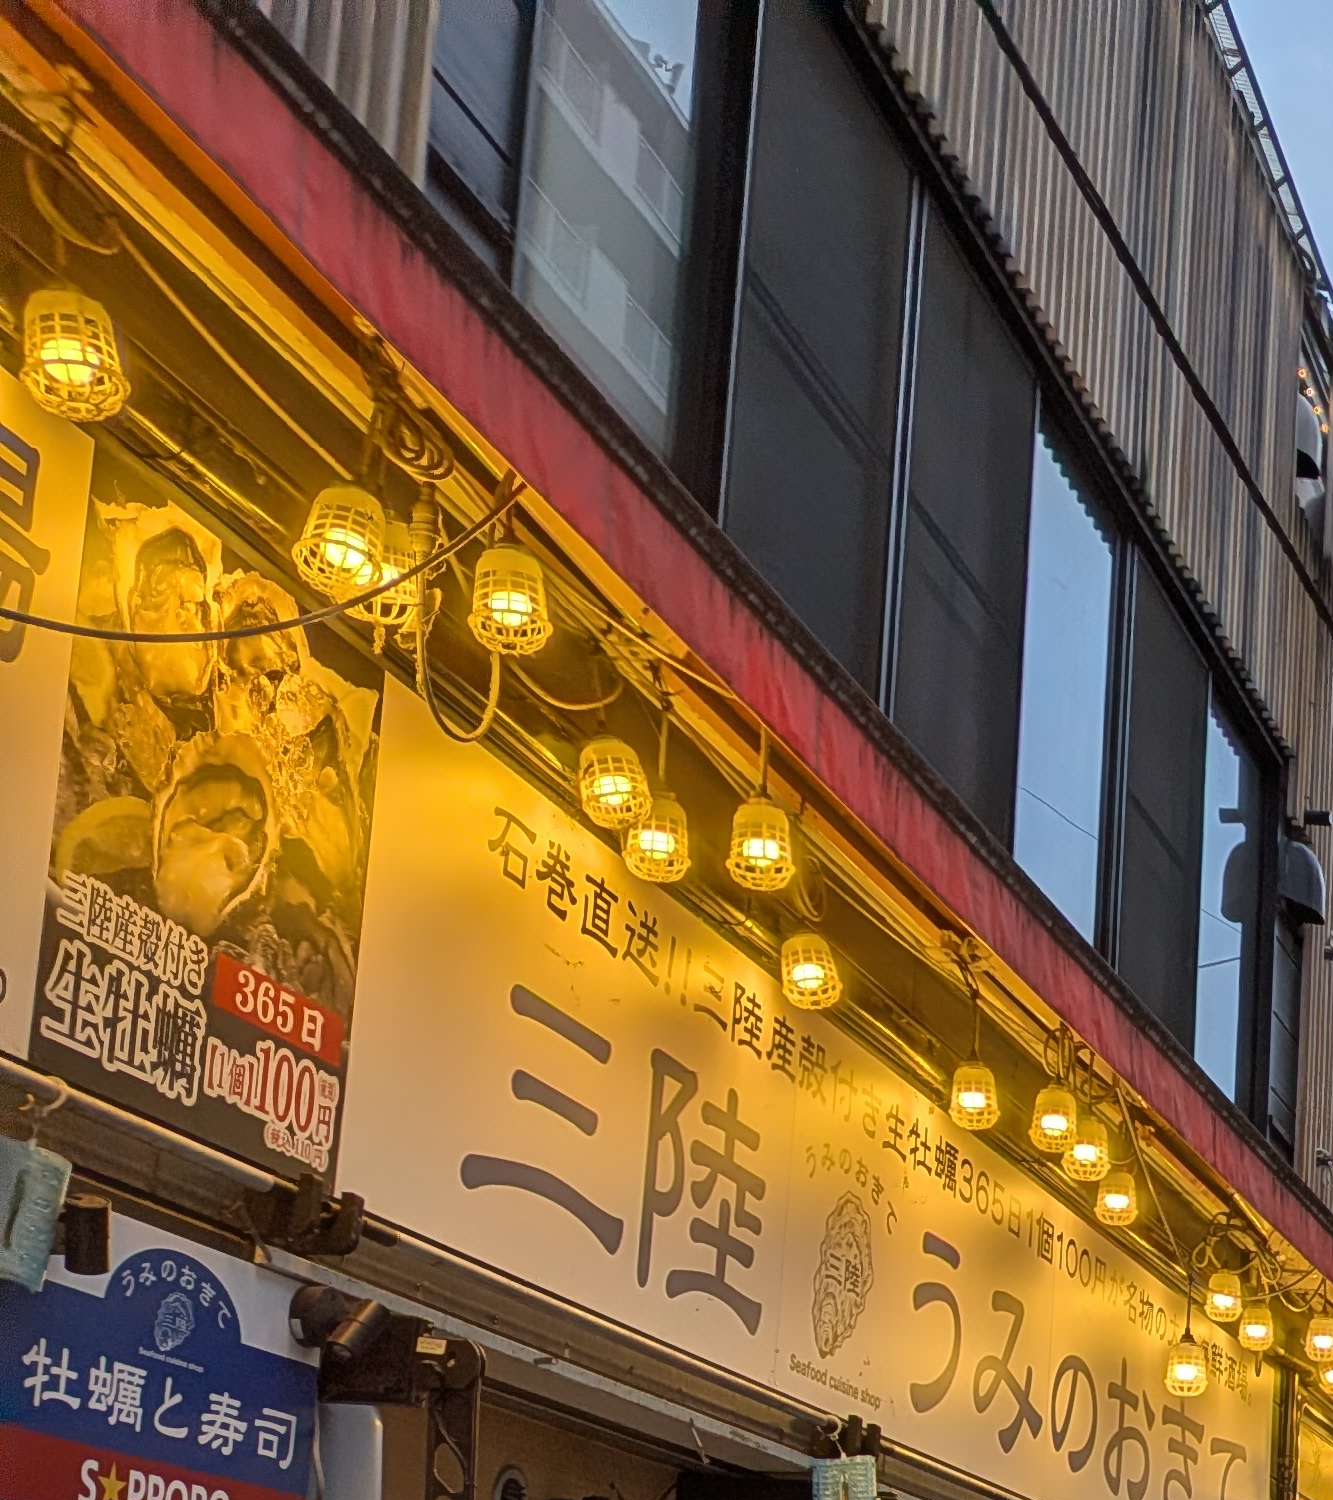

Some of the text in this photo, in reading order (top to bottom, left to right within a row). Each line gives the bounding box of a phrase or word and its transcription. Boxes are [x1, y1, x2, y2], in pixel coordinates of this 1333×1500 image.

[42, 940, 205, 1105] 生牡蠣
[236, 970, 325, 1053] 365日
[460, 984, 767, 1335] 三陸
[121, 1260, 232, 1330] うみのおきて
[22, 1337, 298, 1470] 牡蠣と寿司
[789, 1353, 881, 1411] Seafood cuisine shop
